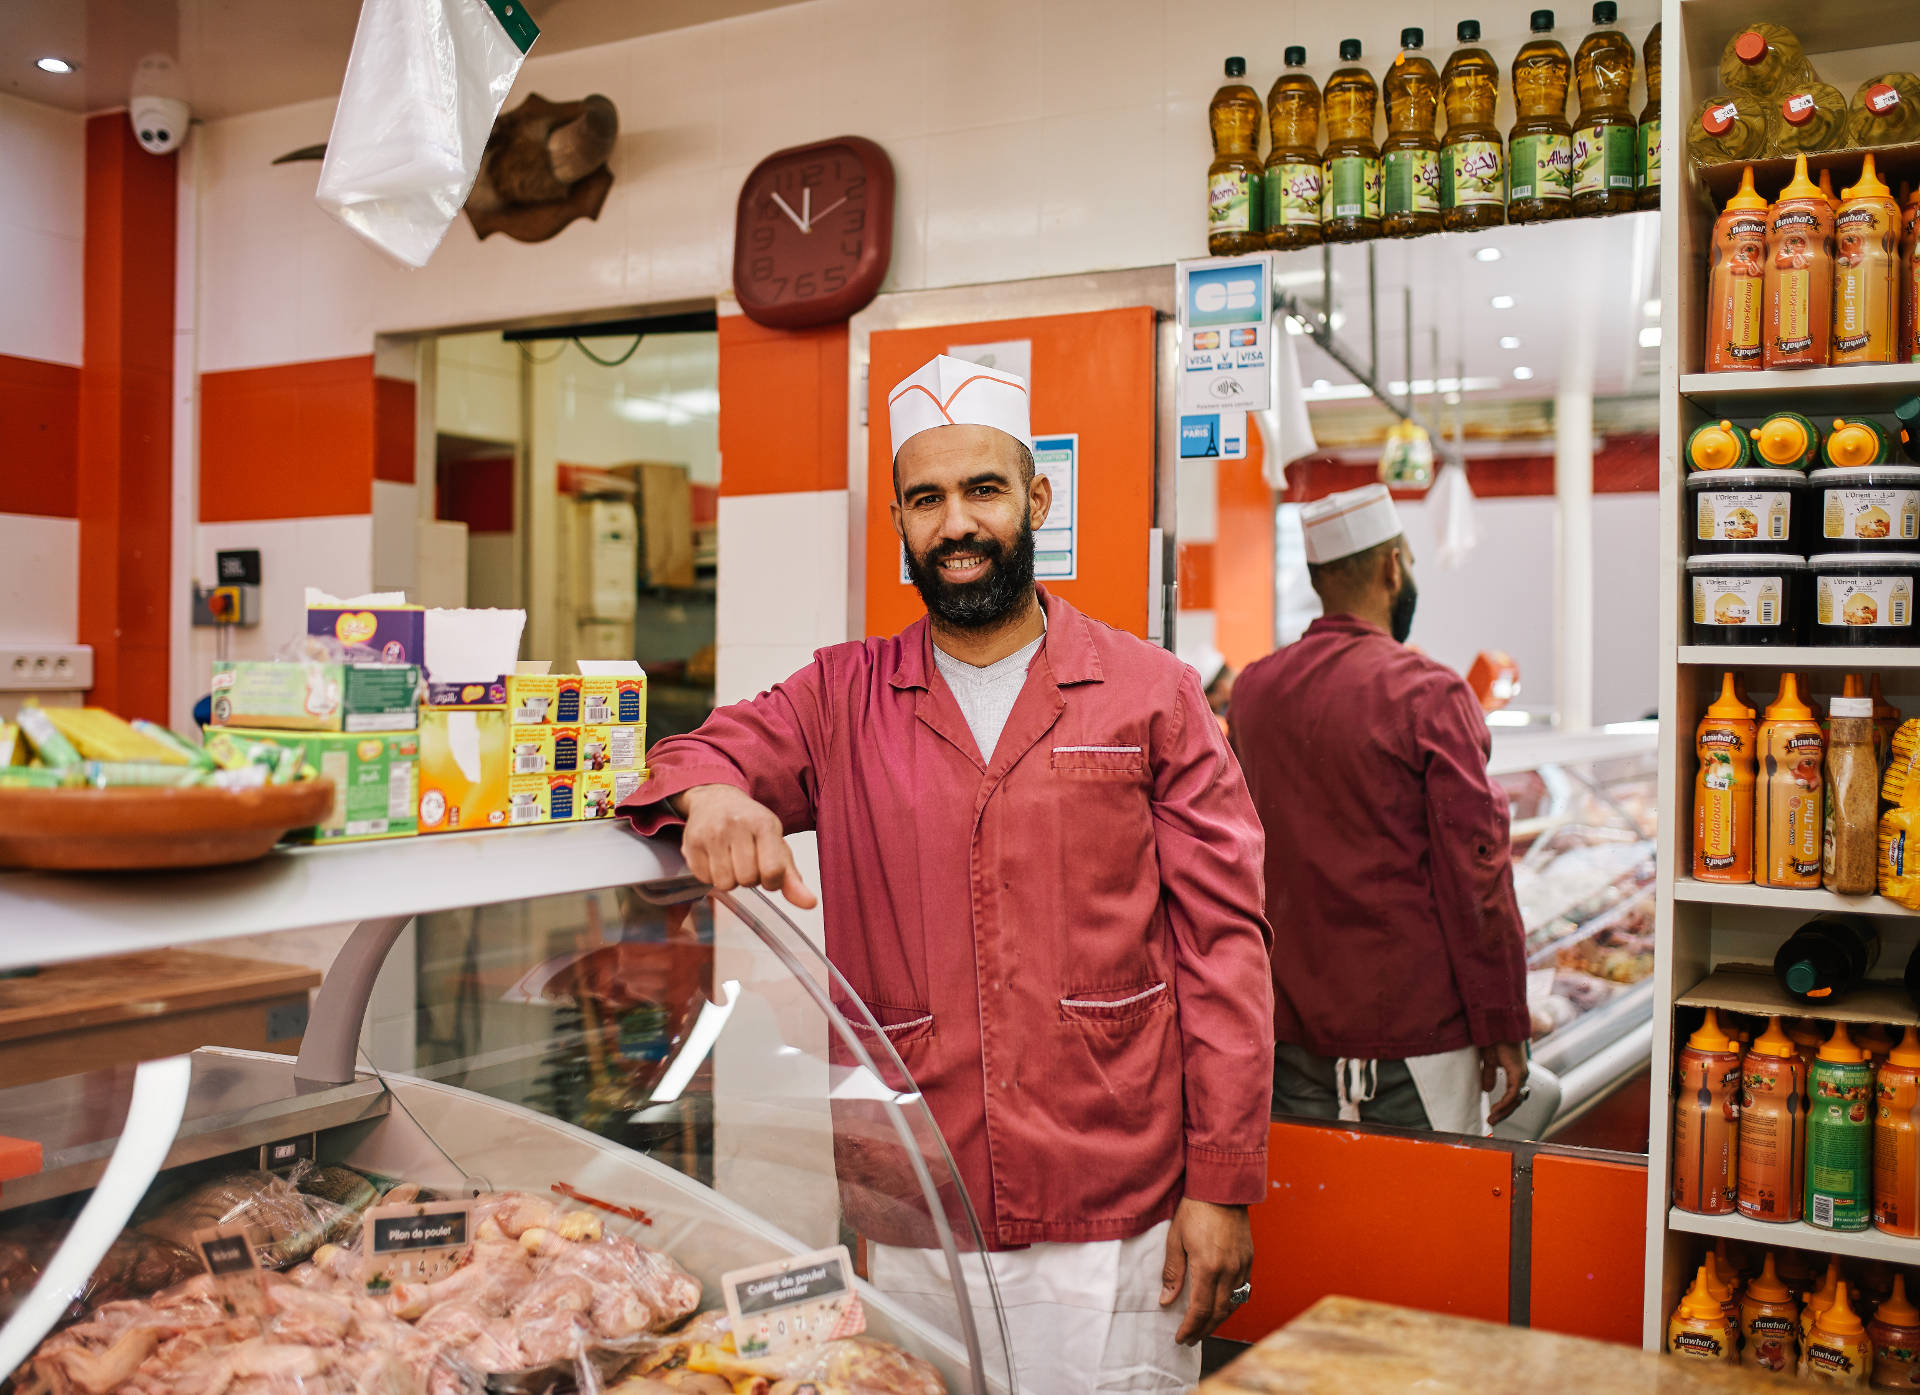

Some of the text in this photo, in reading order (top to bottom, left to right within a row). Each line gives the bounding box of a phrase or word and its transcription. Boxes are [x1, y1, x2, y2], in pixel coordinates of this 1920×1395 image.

[843, 208, 865, 234] 3
[1776, 215, 1814, 227] nawhal's
[752, 226, 775, 251] 9
[840, 240, 863, 261] 4
[752, 256, 774, 283] 8
[823, 265, 847, 292] 5
[771, 276, 789, 303] 7
[794, 271, 816, 299] 6
[1742, 281, 1754, 343] Tomato-Ketchup
[1789, 275, 1800, 337] Tomato-Ketchup
[1190, 354, 1212, 365] VISA
[1241, 351, 1264, 362] VISA
[1183, 429, 1209, 438] PARIS
[1702, 733, 1737, 745] nawhal's
[1711, 794, 1722, 851] Andalouse
[389, 1226, 451, 1241] Pilon de poulet
[748, 1268, 826, 1297] Cuisse de poulet
[772, 1284, 808, 1301] fermier
[1755, 1320, 1791, 1332] nawhal's
[1678, 1336, 1715, 1349] nawhal's
[1810, 1348, 1845, 1364] nawhal's
